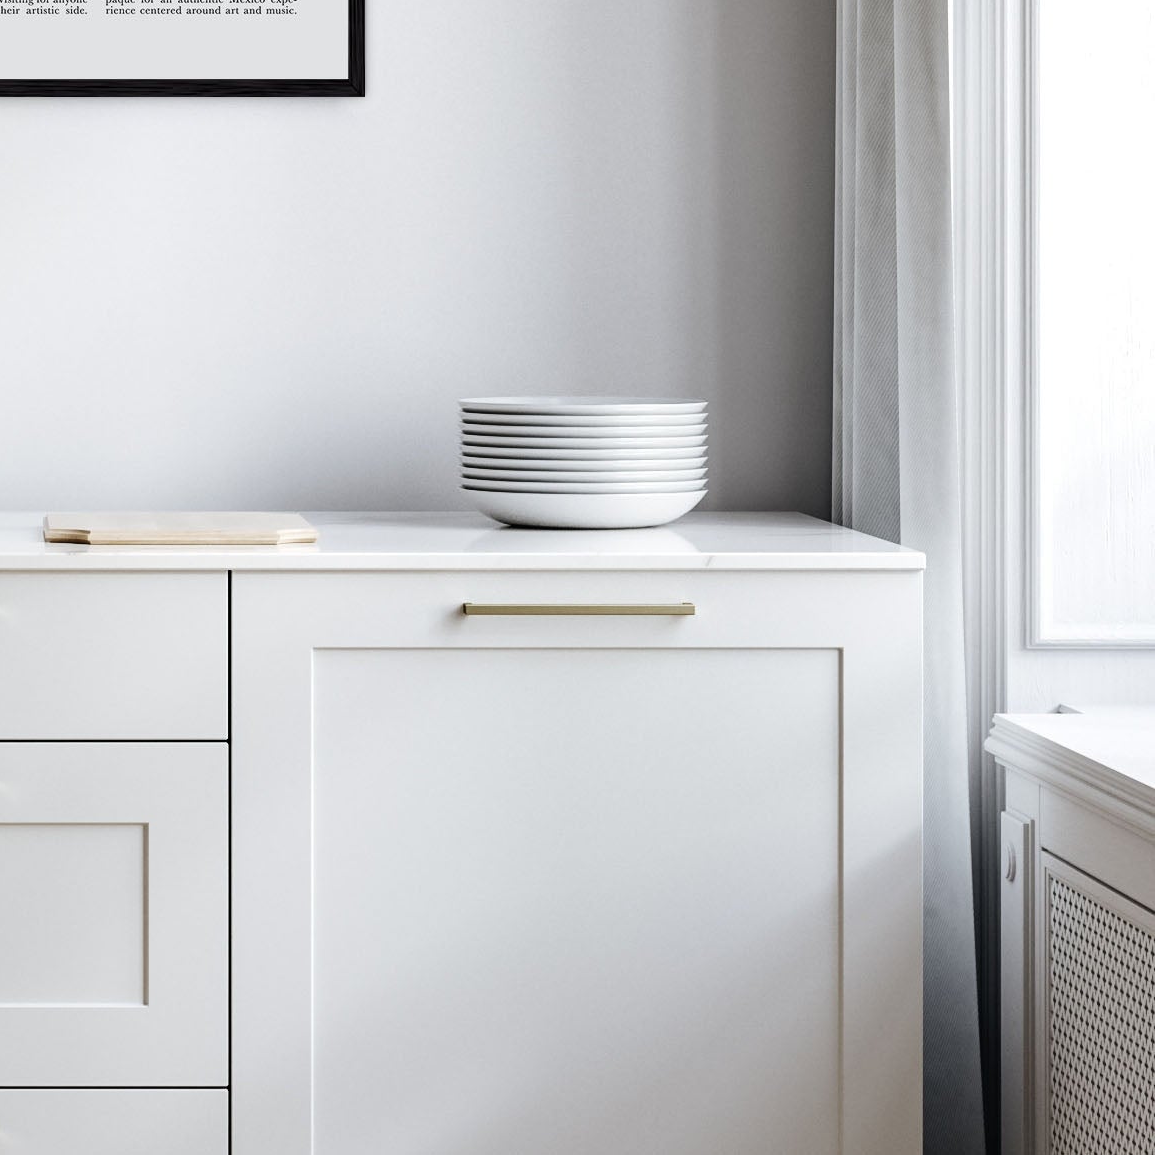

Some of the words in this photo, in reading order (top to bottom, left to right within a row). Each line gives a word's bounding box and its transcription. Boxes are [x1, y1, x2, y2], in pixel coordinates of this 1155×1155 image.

[26, 6, 60, 15] artistic
[65, 6, 88, 15] side.
[105, 6, 136, 15] rience
[139, 6, 182, 15] centered
[186, 6, 222, 15] around
[225, 6, 240, 15] art
[243, 6, 262, 15] and
[266, 6, 297, 15] music.
